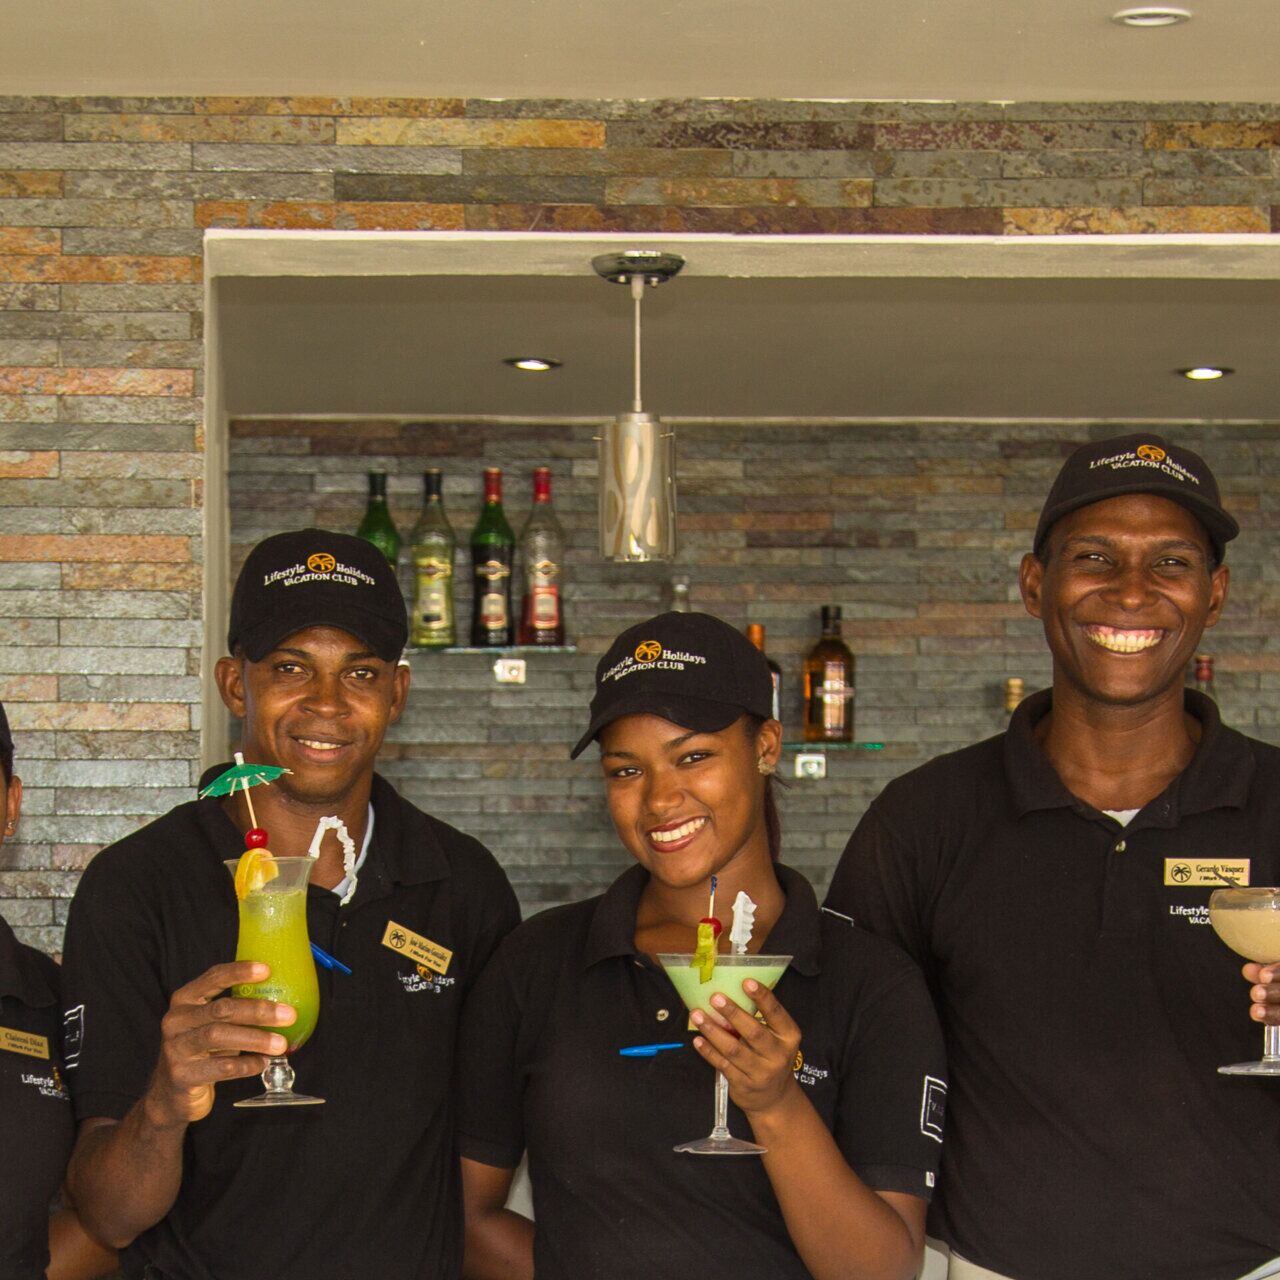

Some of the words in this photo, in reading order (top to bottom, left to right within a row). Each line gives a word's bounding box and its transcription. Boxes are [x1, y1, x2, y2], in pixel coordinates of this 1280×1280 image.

[1089, 452, 1137, 470] Lifestyle
[1165, 455, 1200, 485] Holidays
[1111, 459, 1160, 470] VACATION
[1161, 464, 1185, 481] CLUB
[263, 563, 306, 587] Lifestyle
[336, 562, 376, 586] Holidays
[283, 573, 330, 587] VACATION
[331, 573, 358, 586] CLUB
[662, 649, 707, 664] Holidays
[614, 662, 656, 681] VACATION
[657, 661, 685, 671] CLUB
[1169, 905, 1210, 917] Lifestyle
[1188, 917, 1211, 925] VACA
[21, 1073, 54, 1087] Lifestyle
